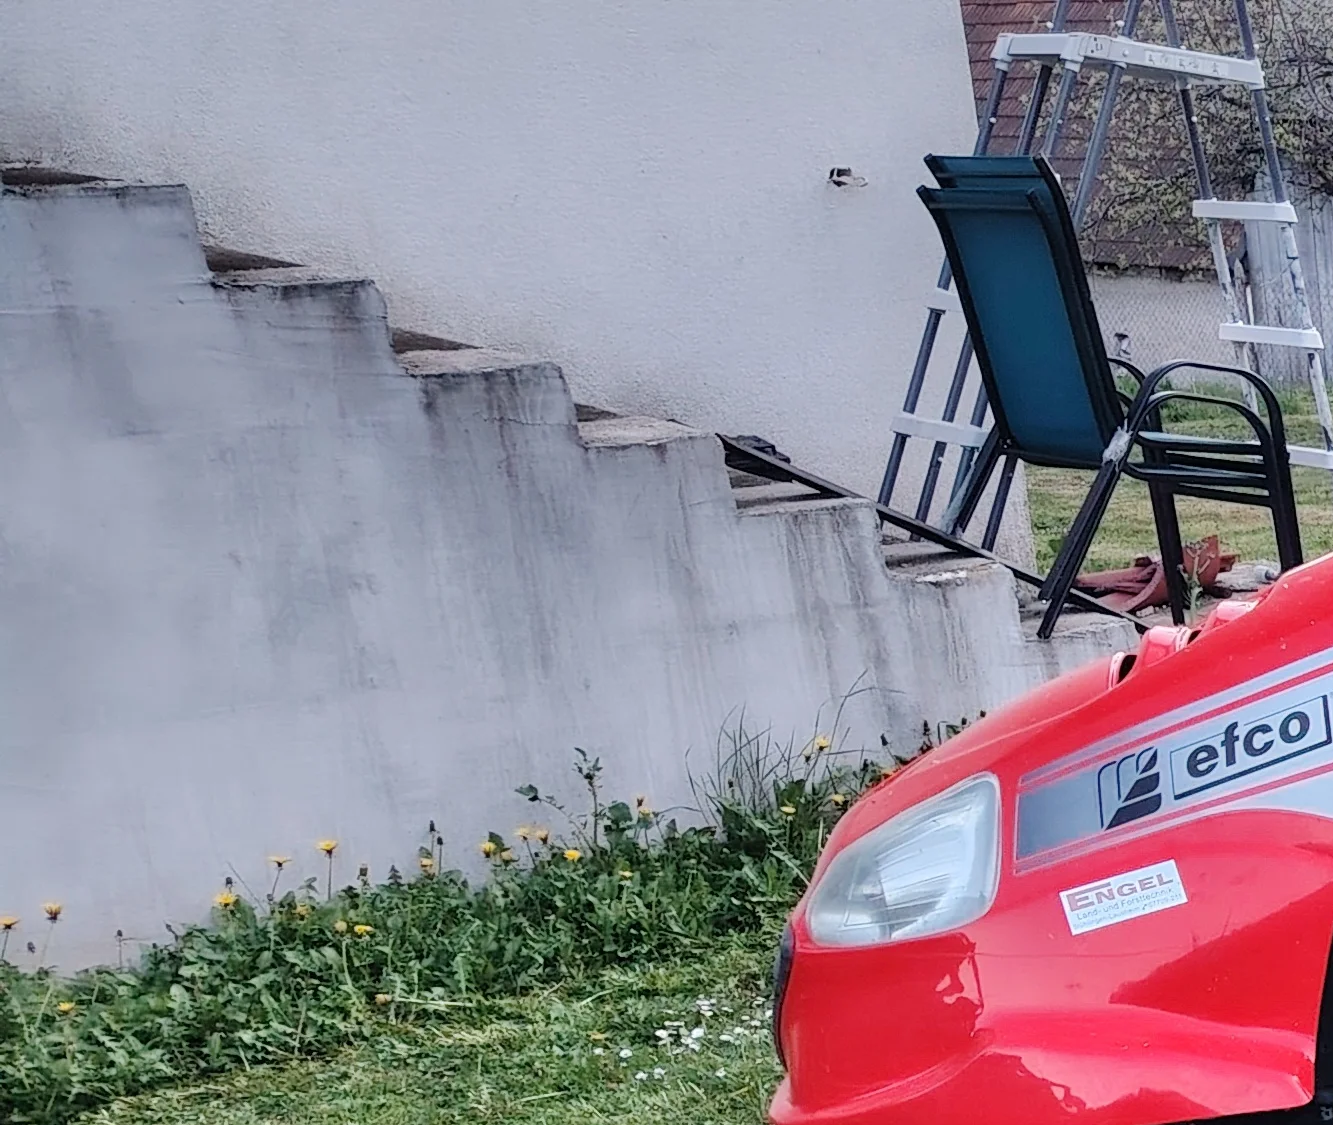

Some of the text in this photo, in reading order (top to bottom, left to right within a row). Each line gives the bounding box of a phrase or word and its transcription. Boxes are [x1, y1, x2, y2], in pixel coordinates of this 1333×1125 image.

[1186, 711, 1310, 778] efco
[1066, 873, 1174, 912] ENGEL
[1104, 902, 1120, 913] und
